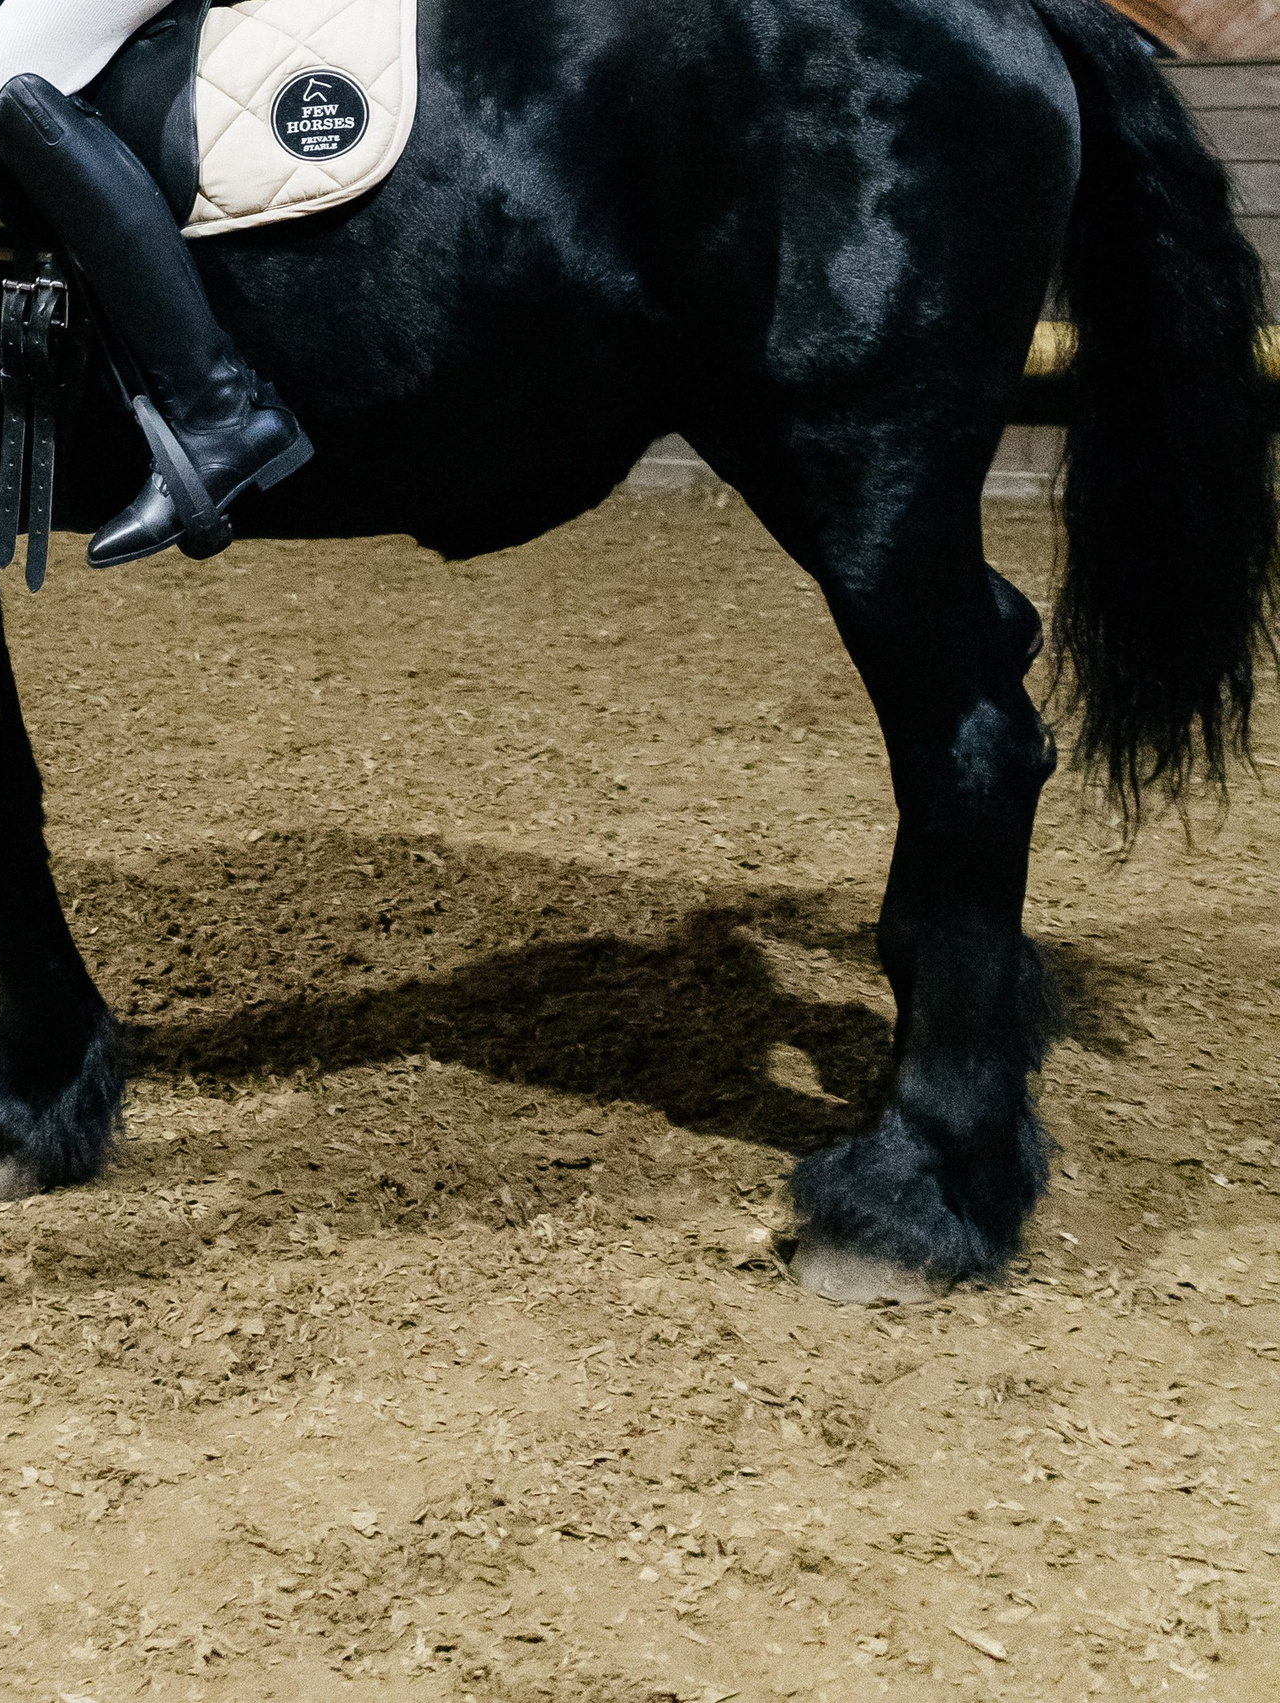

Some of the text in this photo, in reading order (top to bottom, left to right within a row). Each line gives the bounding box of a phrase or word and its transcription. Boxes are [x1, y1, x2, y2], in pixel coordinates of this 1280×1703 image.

[301, 104, 339, 118] FEW
[286, 117, 355, 133] HORSES
[301, 135, 340, 144] PRIVATE
[303, 143, 337, 152] STABLE
